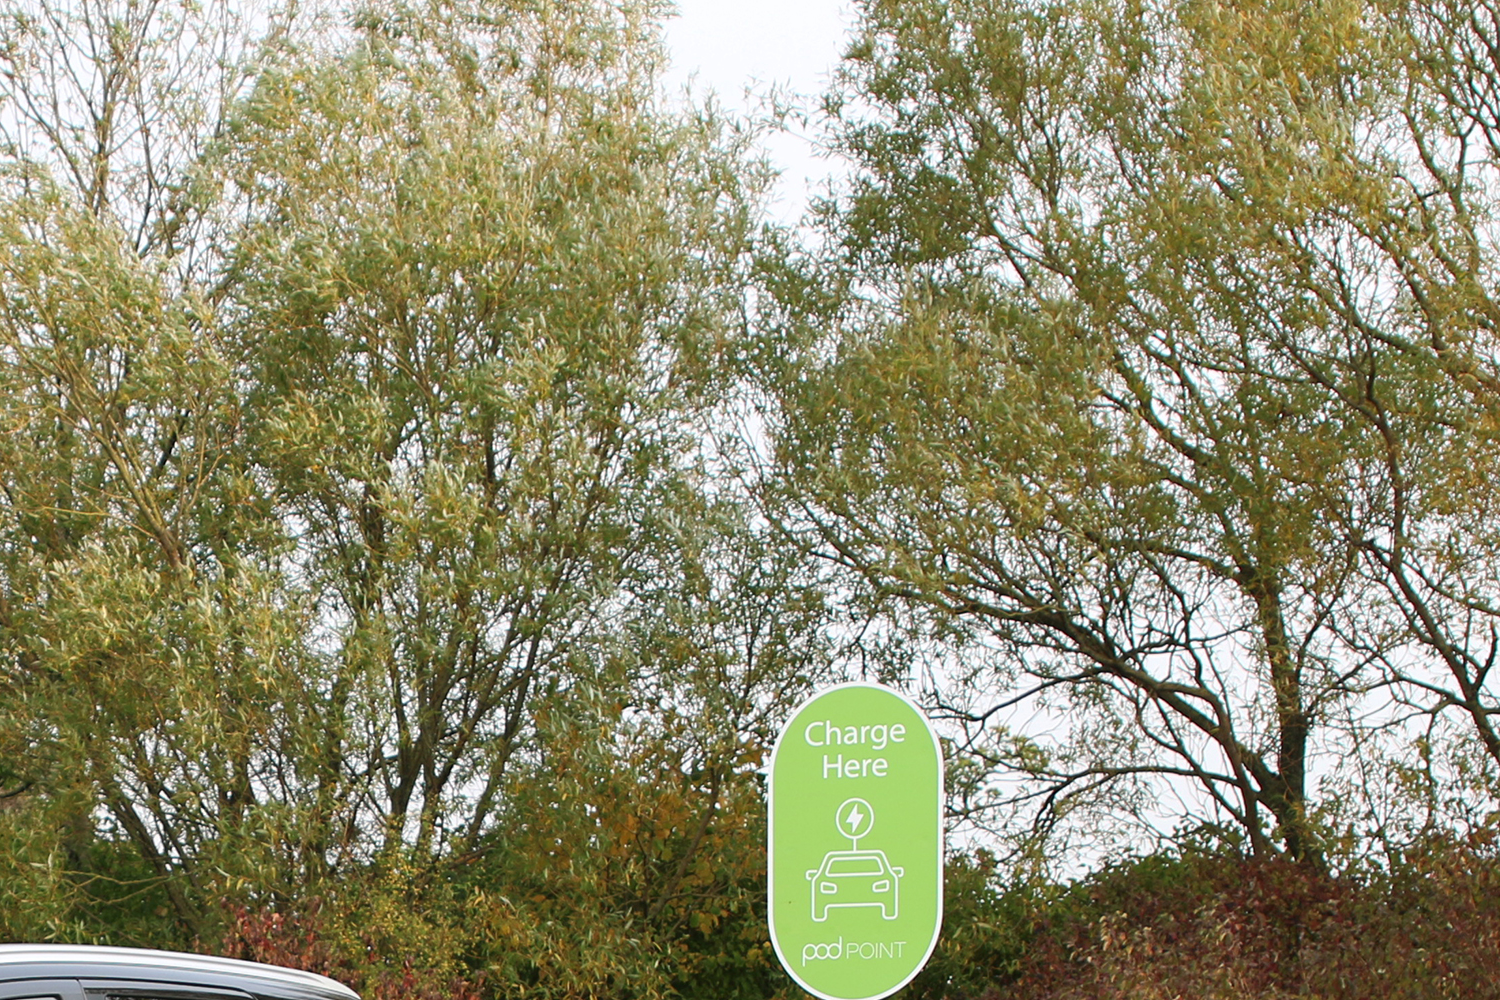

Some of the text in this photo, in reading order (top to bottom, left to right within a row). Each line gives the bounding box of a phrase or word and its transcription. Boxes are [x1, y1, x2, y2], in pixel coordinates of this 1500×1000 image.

[804, 719, 906, 750] Charge
[823, 753, 889, 779] Here
[802, 935, 907, 968] pod POINT
